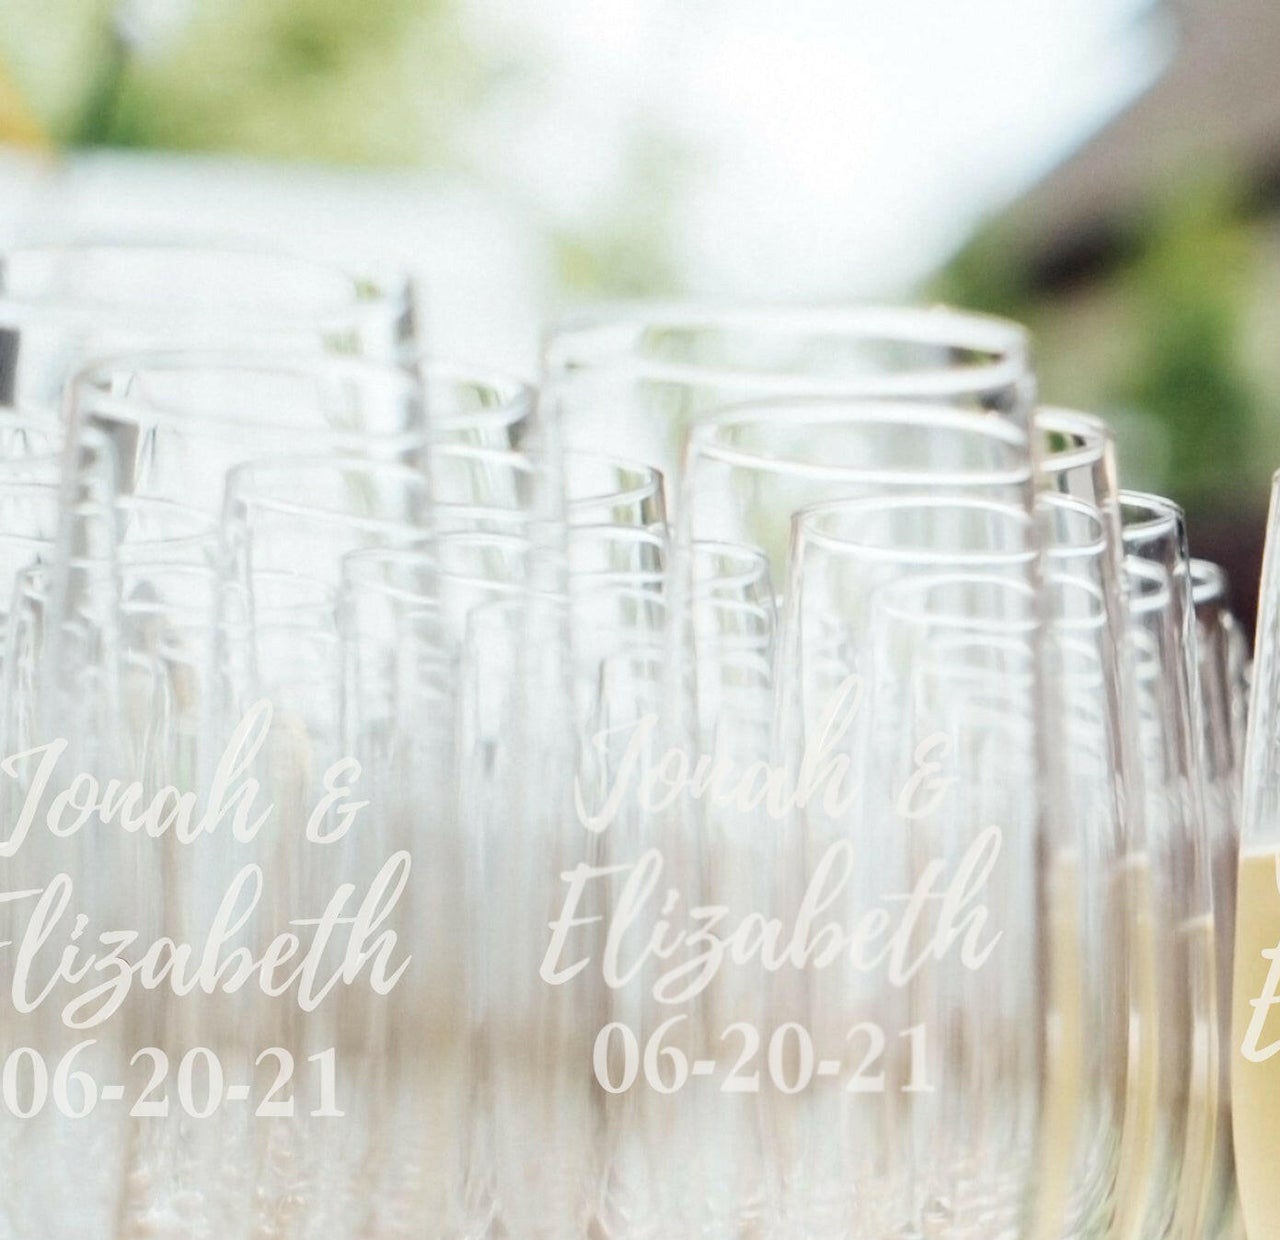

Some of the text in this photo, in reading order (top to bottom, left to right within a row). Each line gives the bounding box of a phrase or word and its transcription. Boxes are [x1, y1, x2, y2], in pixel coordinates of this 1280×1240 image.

[0, 698, 371, 857] Jonah &
[574, 673, 961, 833] Jonah &
[539, 824, 1005, 1005] Elizabeth
[1, 1039, 347, 1119] 06-20-21
[592, 1014, 936, 1094] 06-20-21
